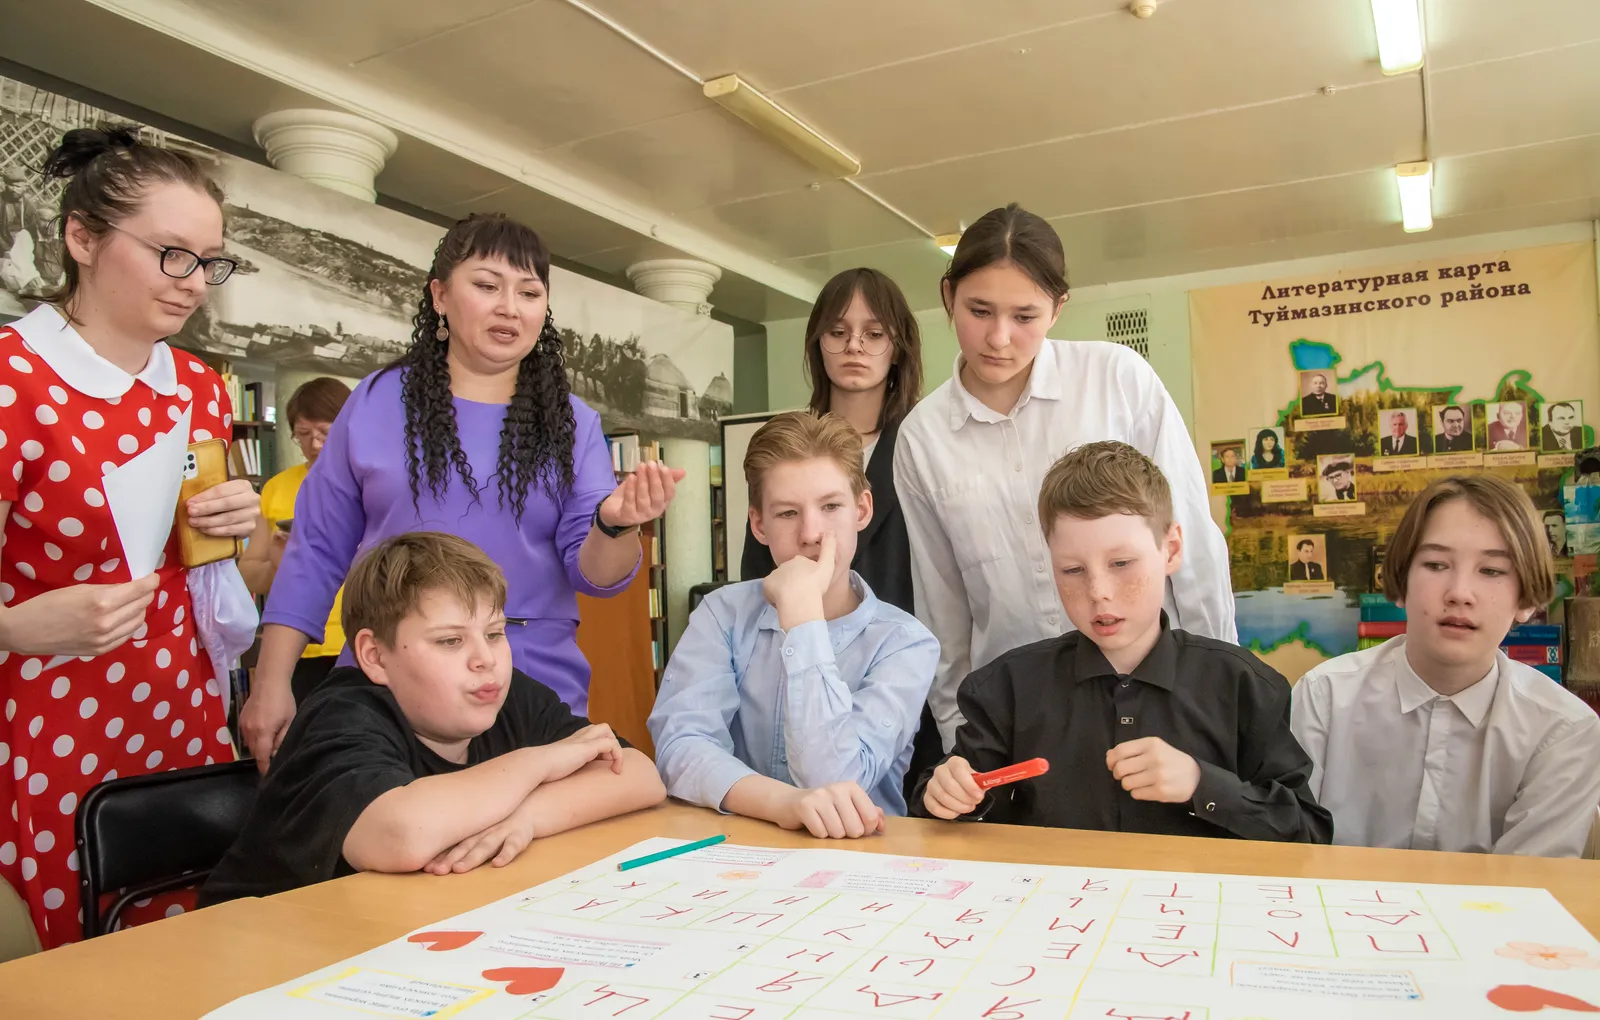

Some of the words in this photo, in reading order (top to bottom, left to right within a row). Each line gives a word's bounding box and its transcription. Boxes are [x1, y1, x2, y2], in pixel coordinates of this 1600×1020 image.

[1261, 268, 1429, 300] Литературная
[1438, 260, 1511, 280] карта
[1248, 294, 1431, 327] Туймазинского
[1441, 283, 1531, 308] района
